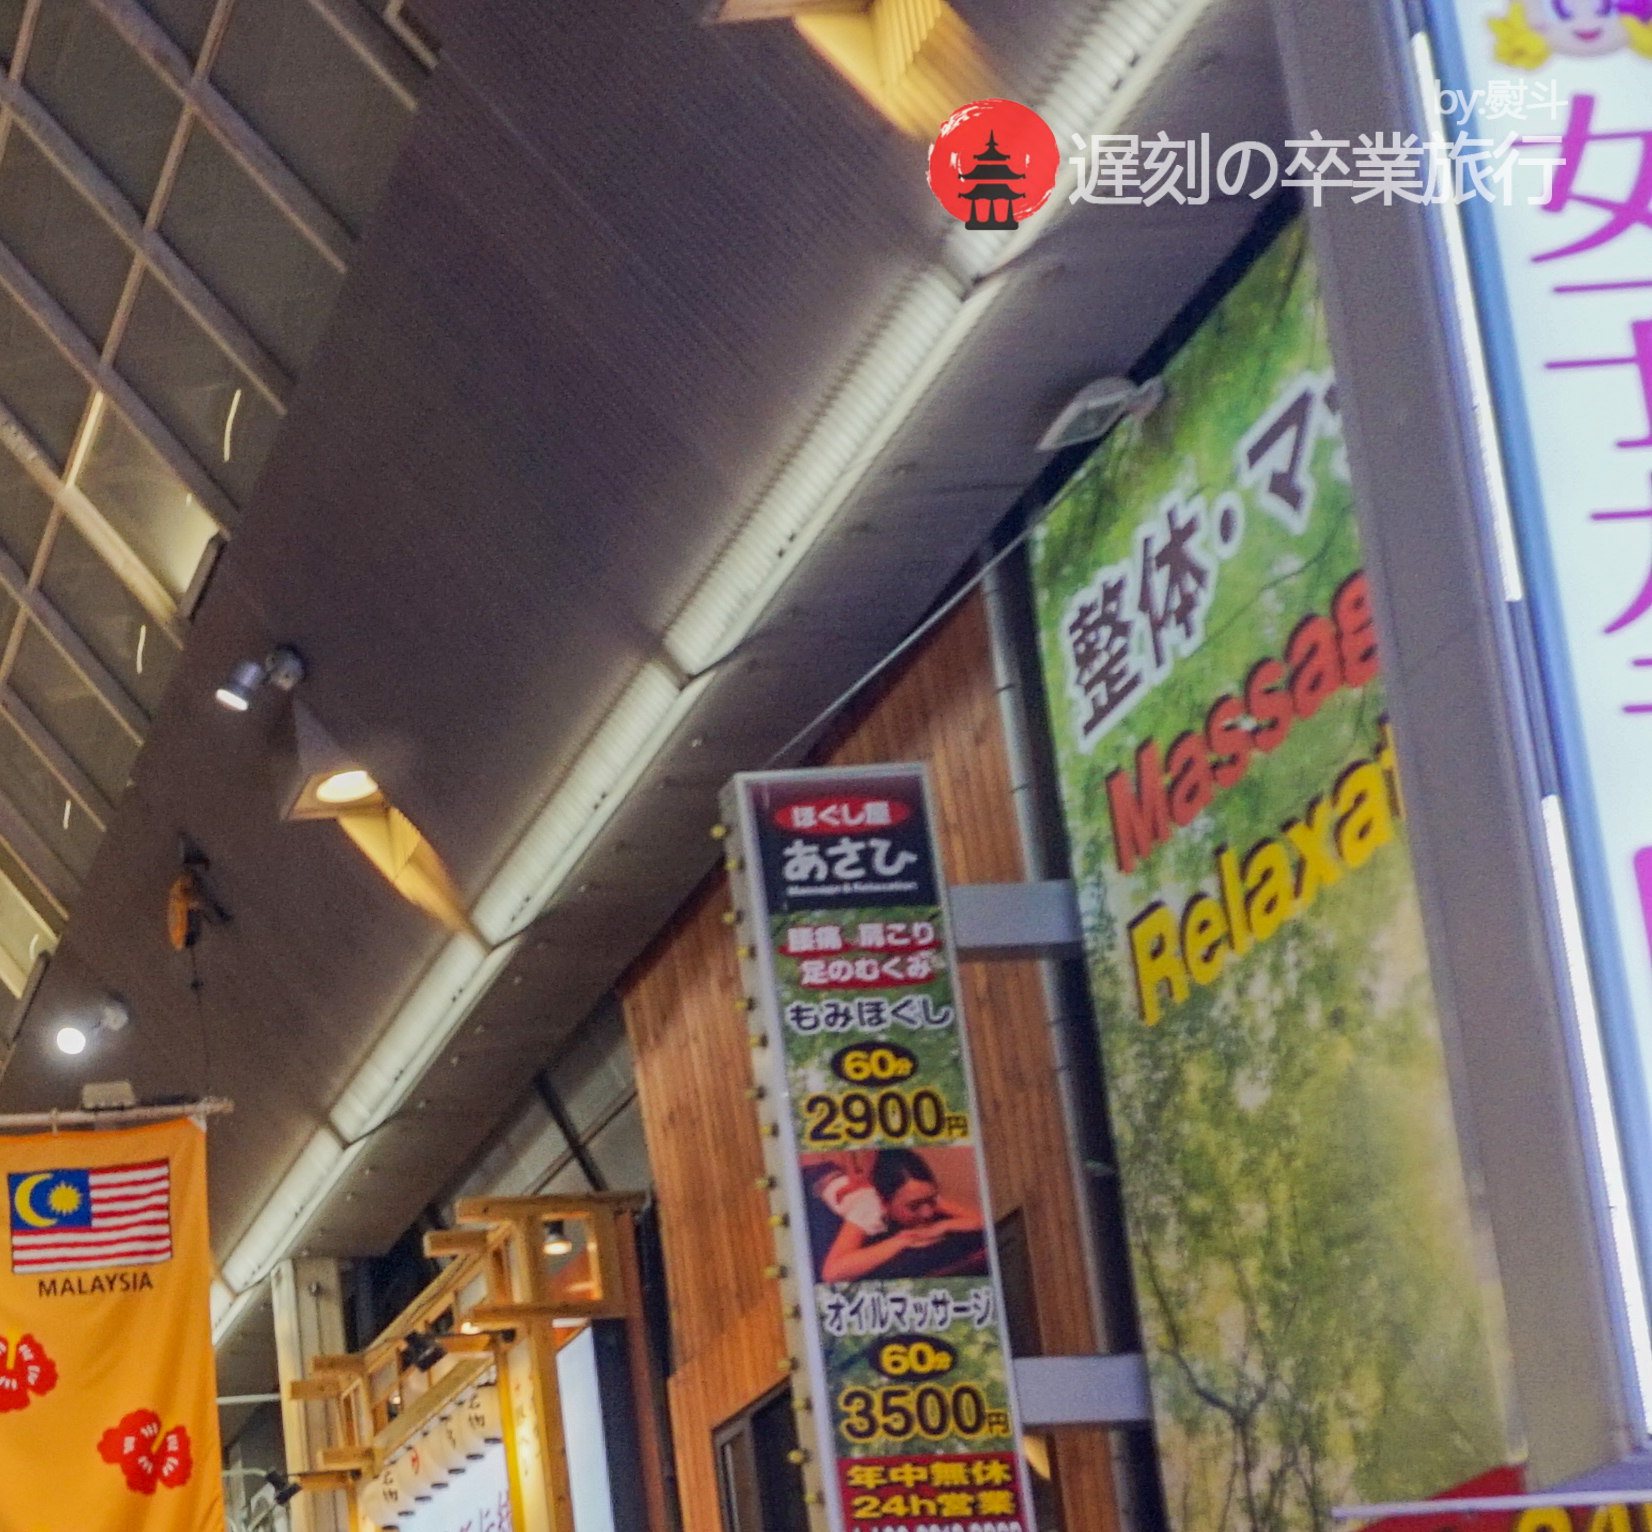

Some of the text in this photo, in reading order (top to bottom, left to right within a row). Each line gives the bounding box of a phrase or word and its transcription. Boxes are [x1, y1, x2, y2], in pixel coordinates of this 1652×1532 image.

[782, 836, 919, 882] あさひ
[788, 996, 953, 1033] もみほぐし
[842, 1050, 913, 1079] 60分
[805, 1090, 969, 1144] 2900円
[38, 1272, 154, 1298] MALAYSIA
[823, 1288, 997, 1336] オイルマッサージ
[880, 1342, 953, 1375] 60分
[840, 1384, 1010, 1442] 3500円
[847, 1461, 1011, 1489] 年中無休
[852, 1490, 1016, 1519] 24h営業
